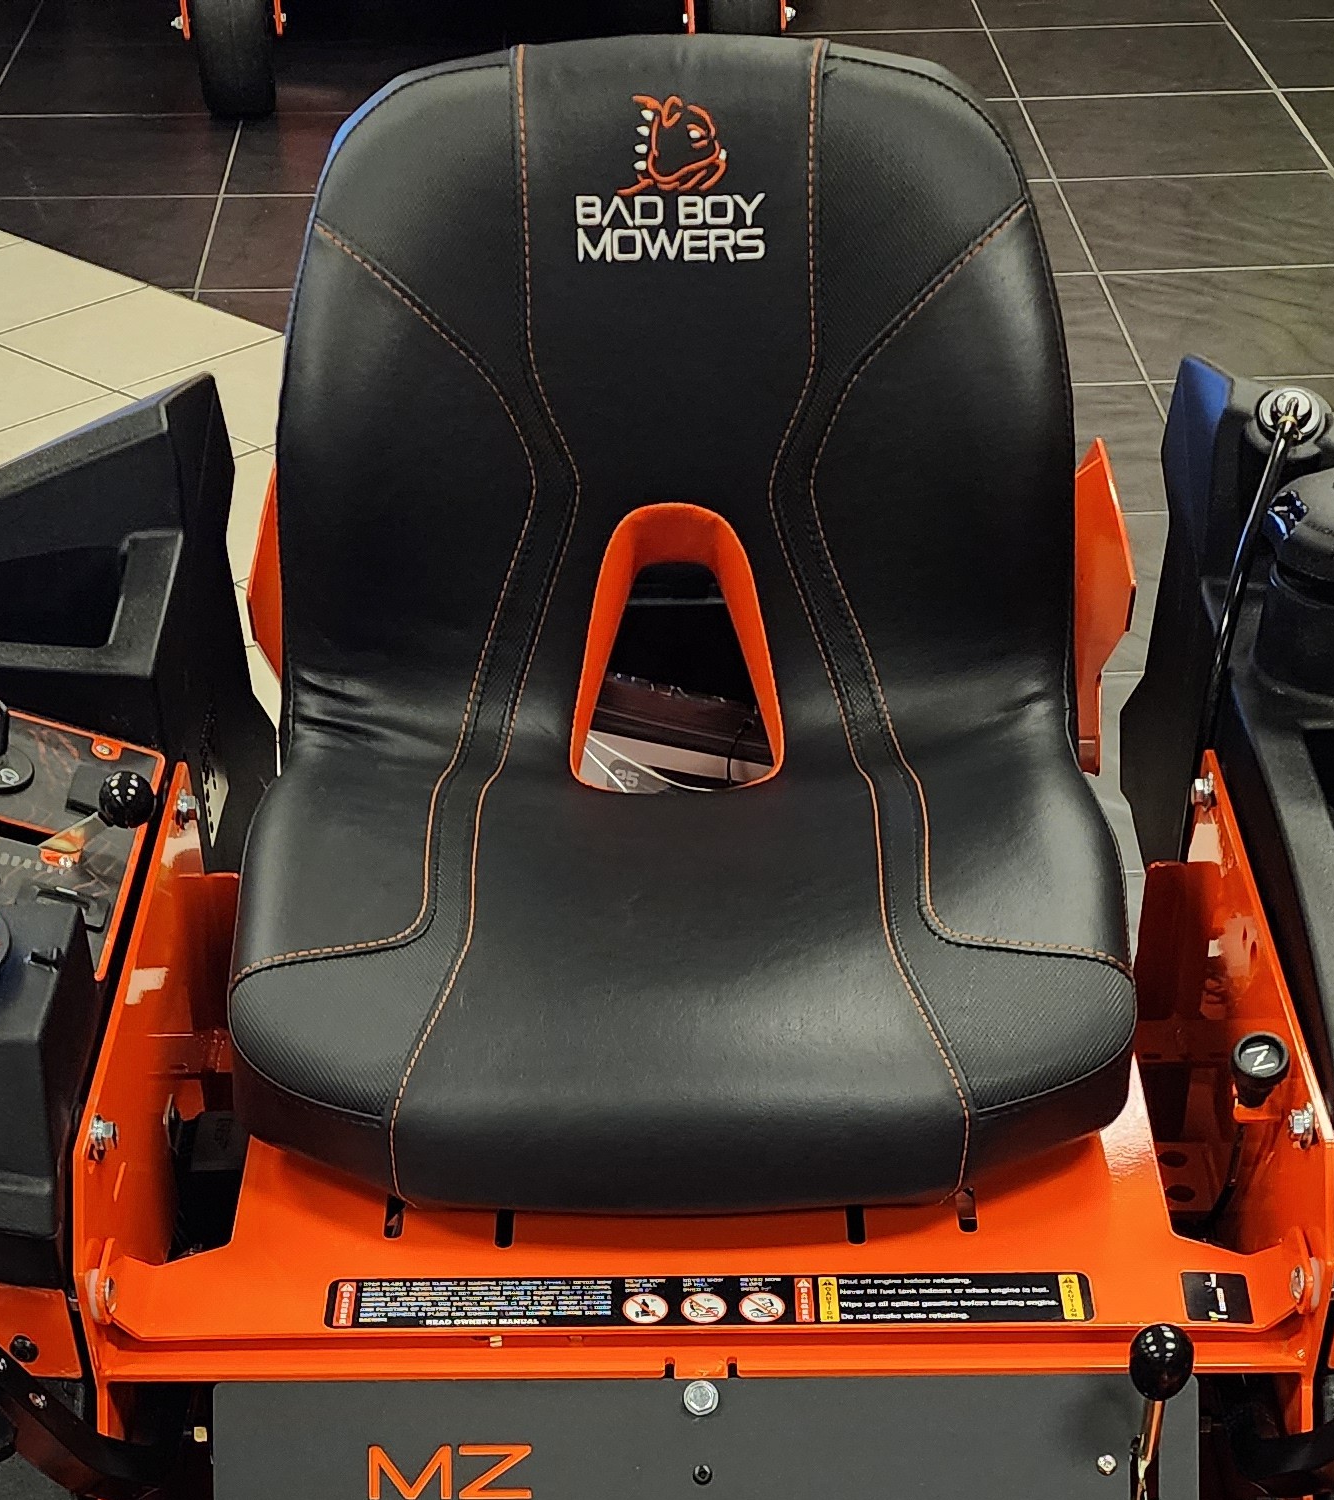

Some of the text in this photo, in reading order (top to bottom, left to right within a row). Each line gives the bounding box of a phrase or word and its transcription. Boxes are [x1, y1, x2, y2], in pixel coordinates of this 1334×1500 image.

[576, 193, 766, 227] BAD BOY
[577, 227, 765, 262] MOWERS
[368, 1443, 533, 1500] MZ
